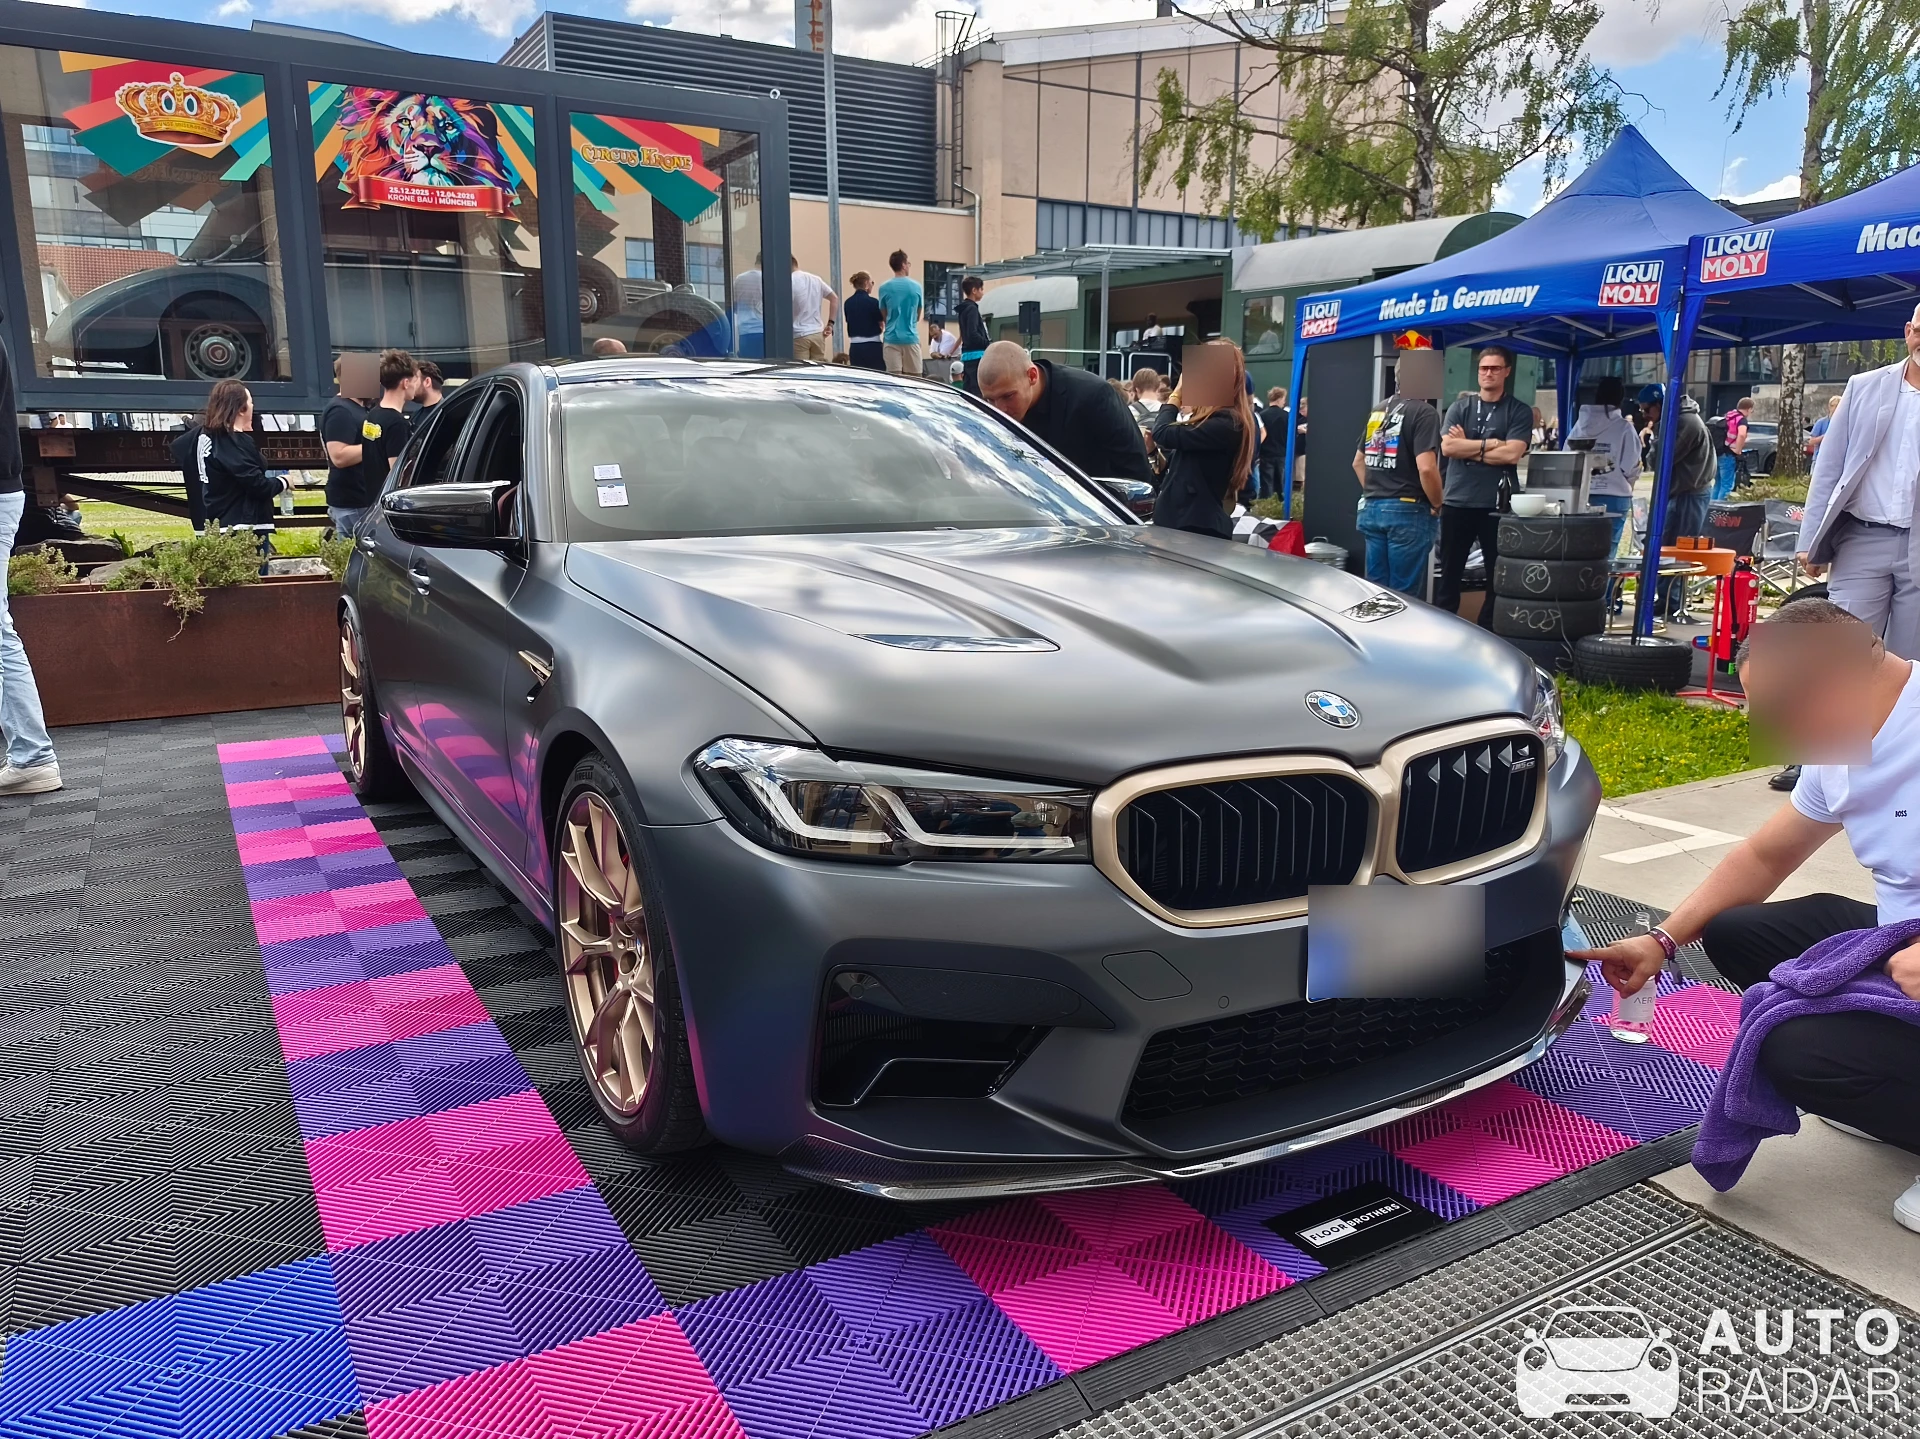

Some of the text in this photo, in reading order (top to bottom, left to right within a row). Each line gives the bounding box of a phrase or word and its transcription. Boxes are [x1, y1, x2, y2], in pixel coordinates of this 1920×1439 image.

[581, 144, 693, 171] CIRCUS KRONE
[387, 194, 415, 203] KRONE
[417, 195, 433, 204] BAU
[438, 196, 478, 207] MÜNCHEN
[388, 187, 430, 197] 25.12.2025
[436, 190, 475, 200] 12.04.2026
[1706, 231, 1770, 258] LIQUI
[1605, 263, 1660, 285] LIQUI
[1703, 252, 1765, 280] MOLY
[1378, 284, 1540, 321] Made in Germany
[1600, 283, 1658, 306] MOLY
[1304, 301, 1339, 320] LIQUI
[1302, 316, 1339, 337] MOLY
[1633, 996, 1655, 1005] AER
[1309, 1203, 1401, 1241] FLOOR BROTHERS
